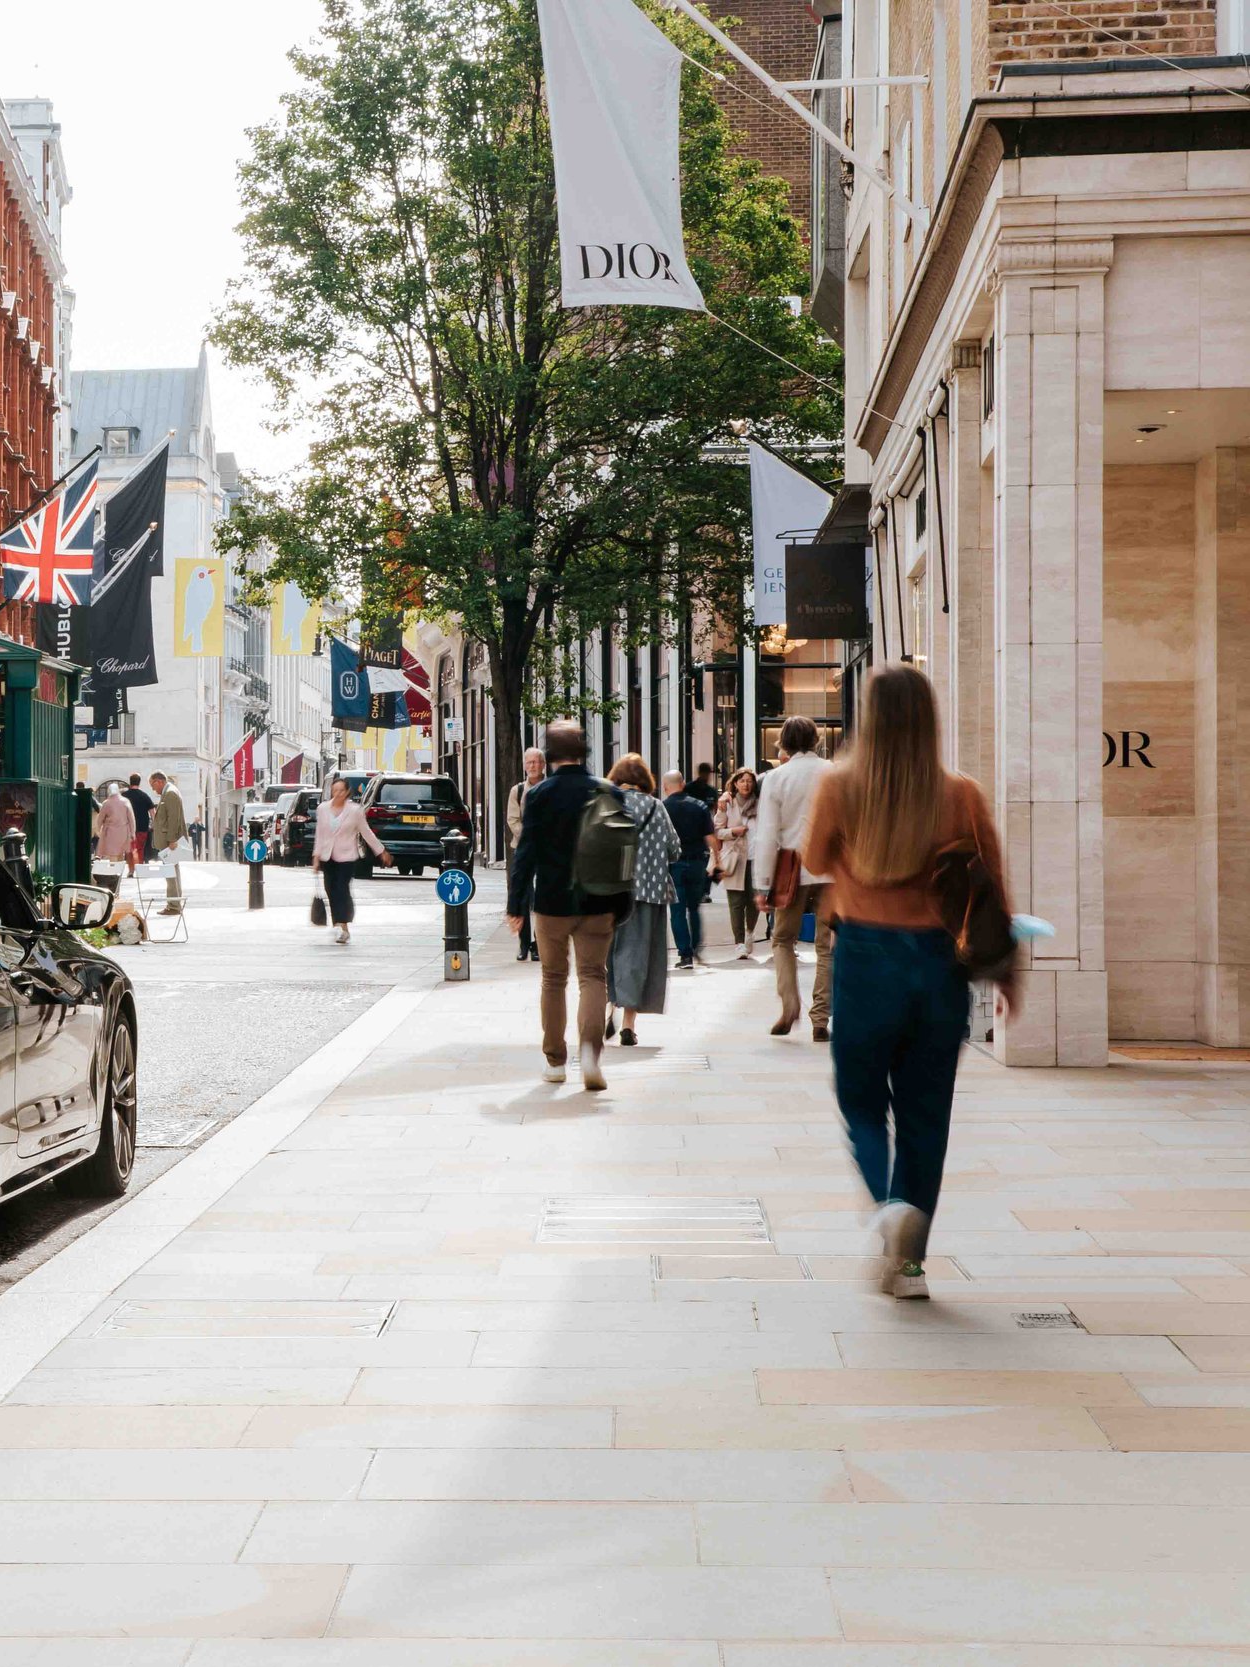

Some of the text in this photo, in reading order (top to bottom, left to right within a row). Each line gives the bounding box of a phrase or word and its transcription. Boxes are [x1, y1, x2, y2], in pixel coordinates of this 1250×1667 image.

[576, 243, 679, 284] DIOR
[96, 654, 150, 676] Chopard
[363, 646, 400, 665] PIAGET
[344, 686, 355, 695] W
[346, 677, 353, 686] H
[371, 693, 380, 719] CHAN
